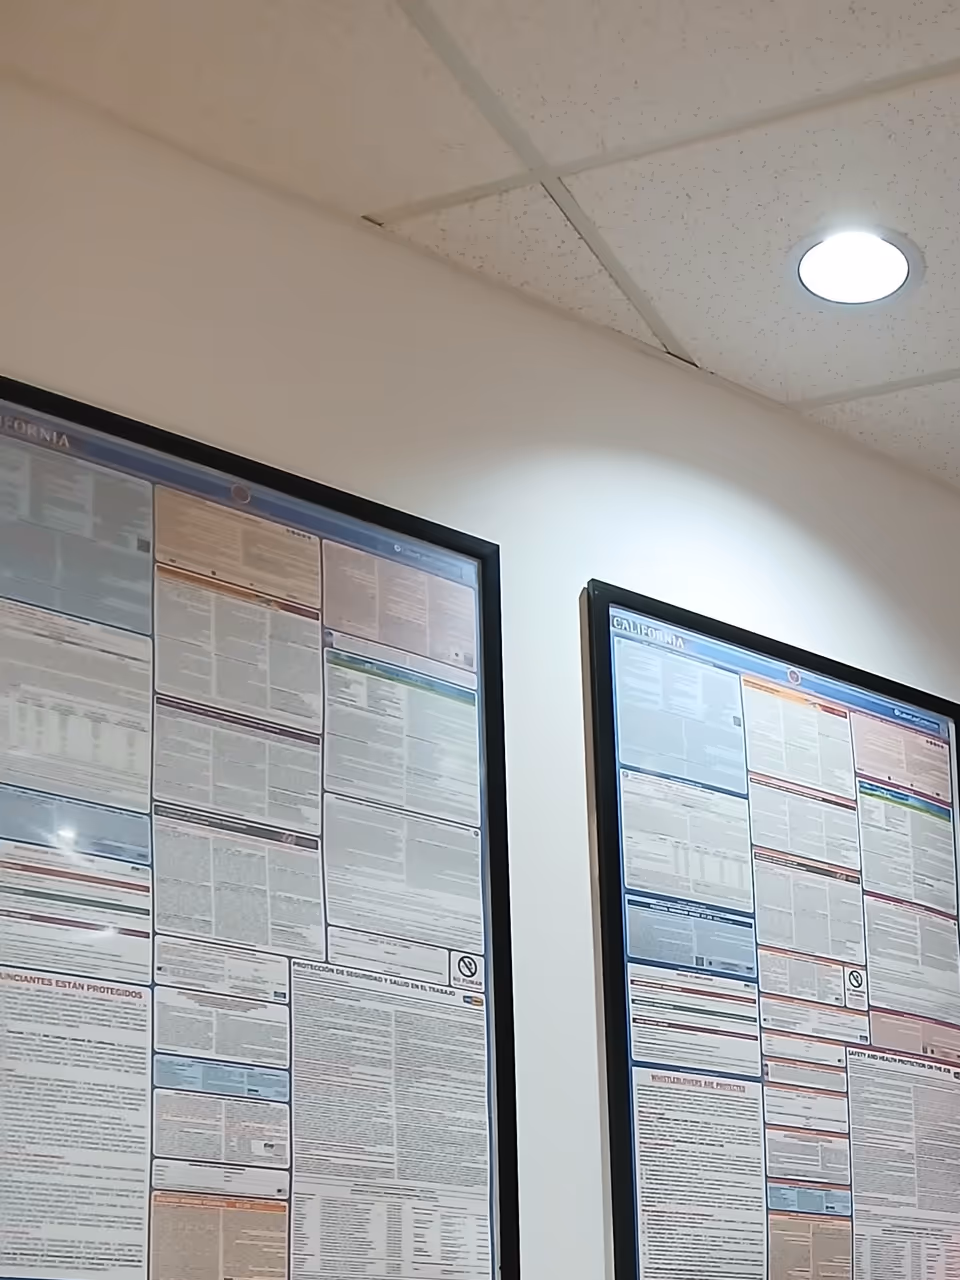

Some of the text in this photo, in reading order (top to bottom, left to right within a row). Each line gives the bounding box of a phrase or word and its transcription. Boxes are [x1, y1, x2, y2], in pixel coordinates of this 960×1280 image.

[612, 616, 685, 650] CALIFORNIA
[55, 978, 85, 991] ESTÁN
[86, 984, 143, 999] PROTEGIDOS
[335, 968, 346, 976] DE
[345, 970, 384, 983] SEGURIDAD
[389, 978, 410, 989] SALUD
[410, 982, 420, 990] EN
[420, 984, 427, 992] EL
[428, 985, 456, 997] TRABAJO
[848, 1049, 867, 1059] SAFETY
[867, 1053, 879, 1061] AND
[879, 1055, 898, 1064] HEALTH
[898, 1057, 927, 1069] PROTECTION
